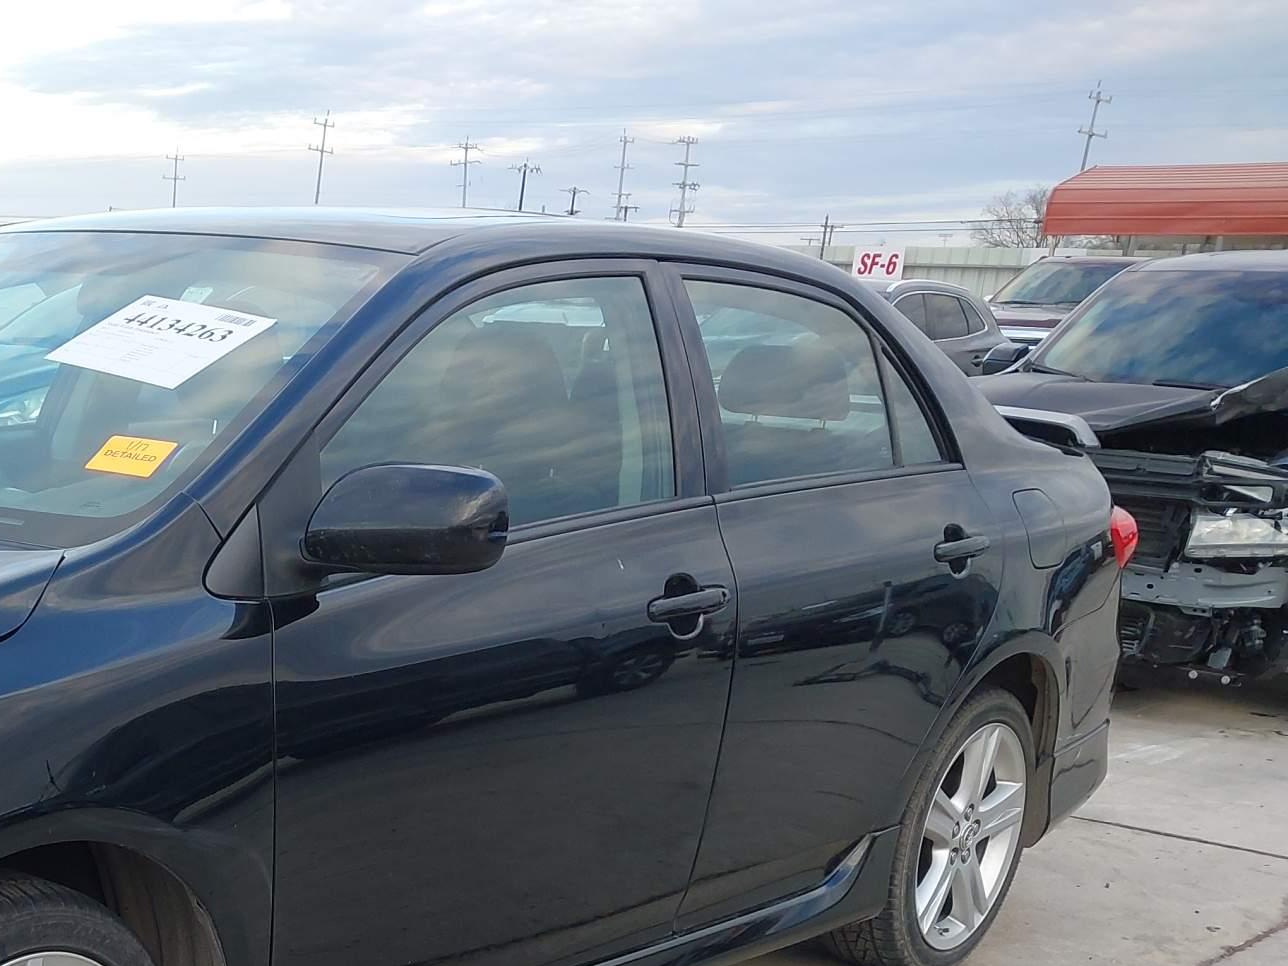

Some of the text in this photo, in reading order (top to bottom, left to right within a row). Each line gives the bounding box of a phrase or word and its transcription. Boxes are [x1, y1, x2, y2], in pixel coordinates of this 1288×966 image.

[857, 253, 899, 275] SF-6
[123, 312, 234, 342] 44134263
[103, 449, 158, 463] DETAILED
